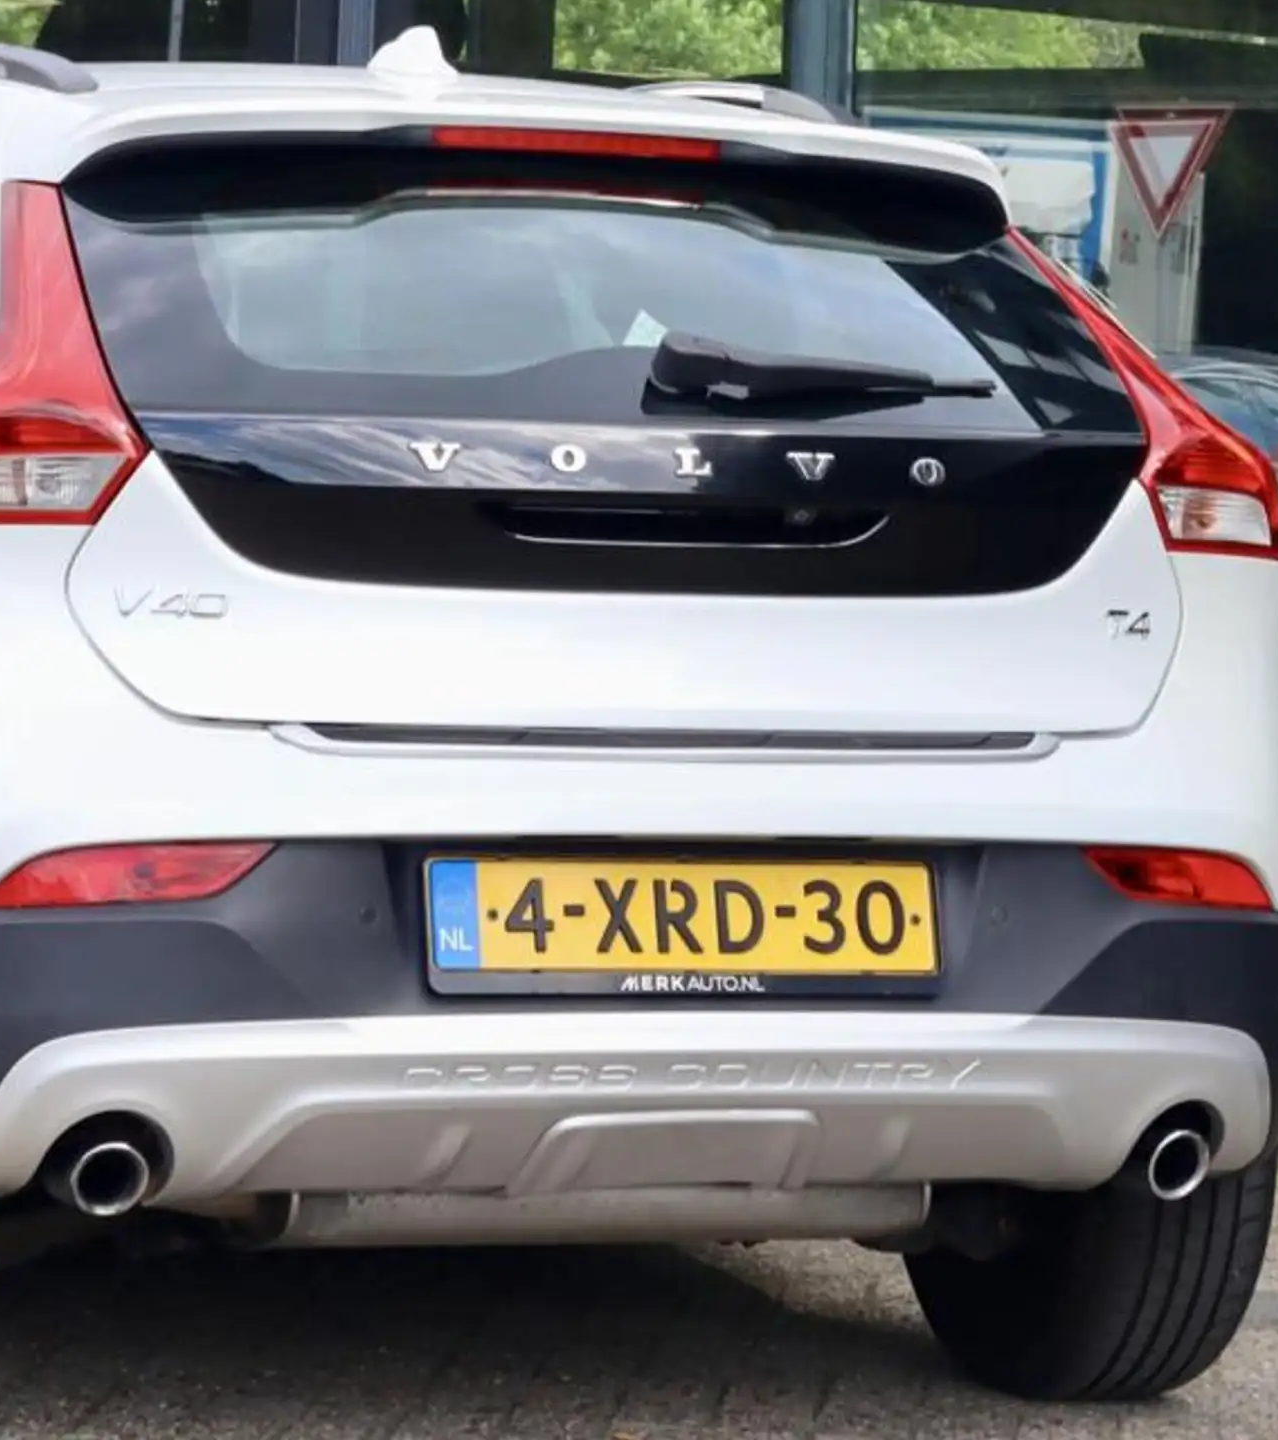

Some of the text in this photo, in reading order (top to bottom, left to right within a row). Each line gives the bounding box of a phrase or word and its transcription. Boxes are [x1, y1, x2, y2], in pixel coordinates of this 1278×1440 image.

[409, 441, 946, 486] VOLVO
[113, 582, 229, 620] V40
[1107, 609, 1151, 640] T4
[438, 877, 906, 956] NL 4-XRD-30
[620, 975, 765, 993] MERKAUTO.NL
[404, 1056, 983, 1091] CROSS COUNTRY
